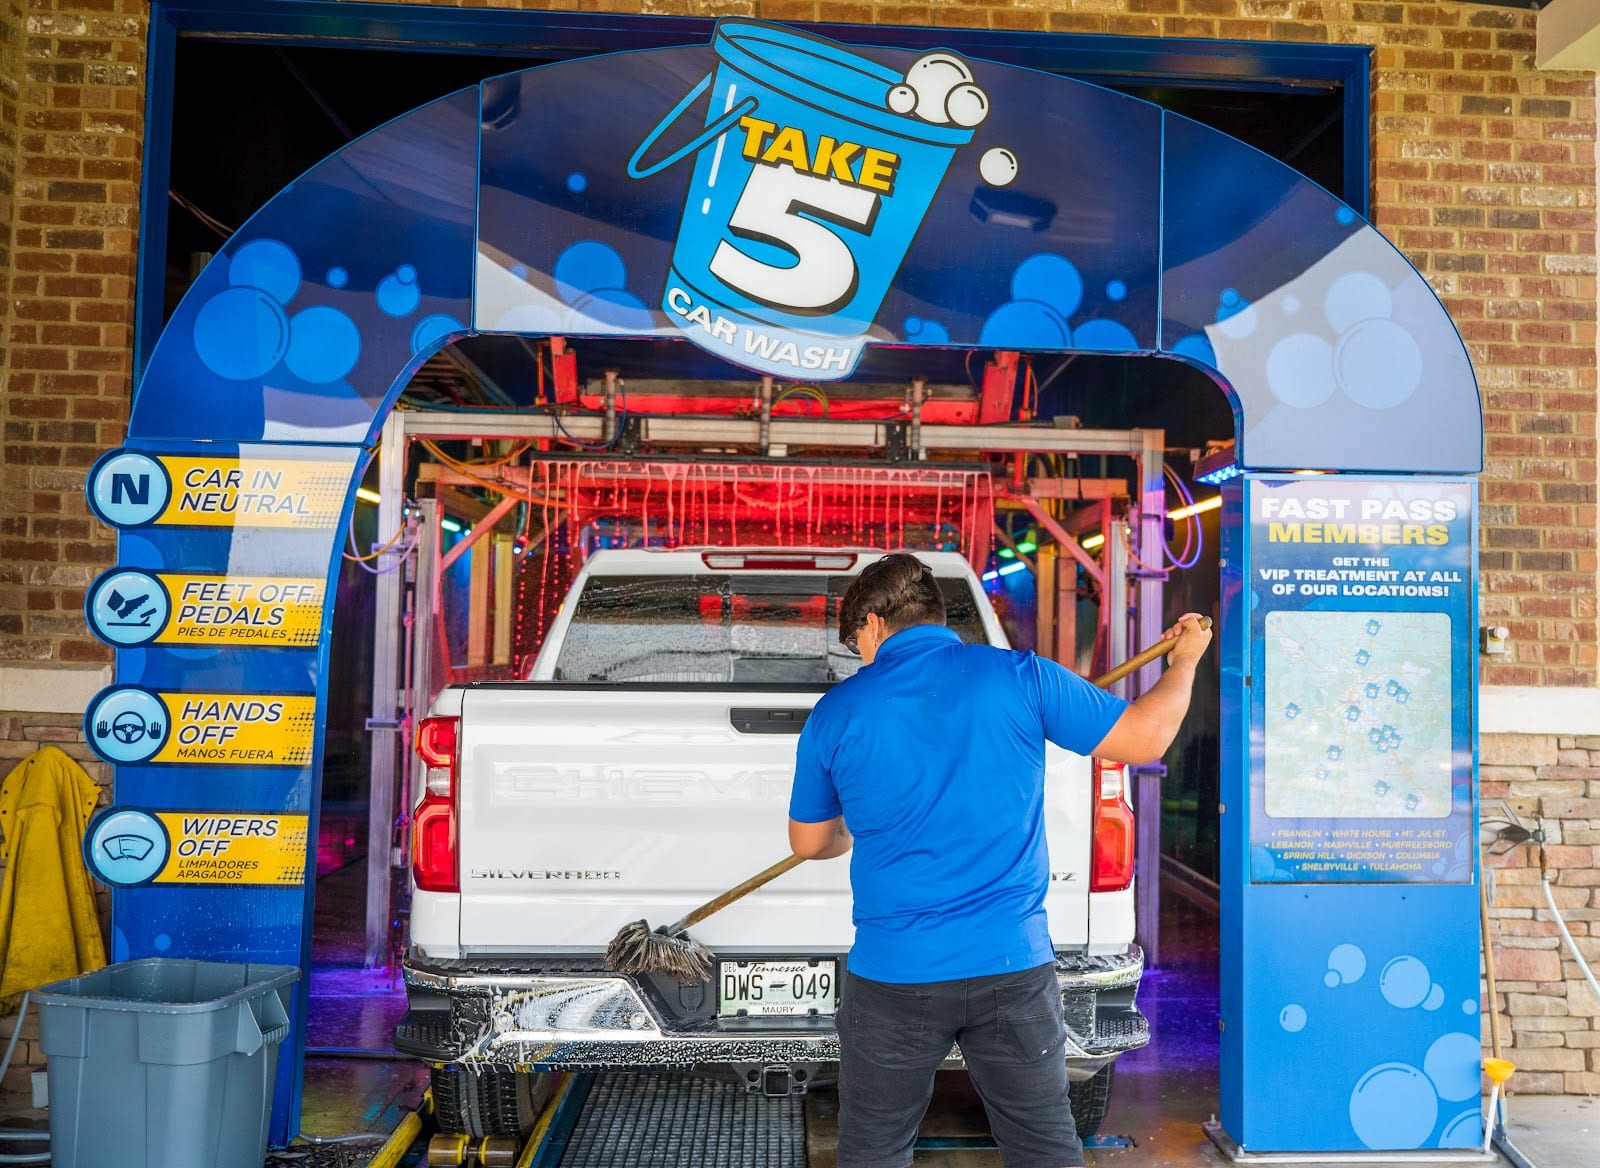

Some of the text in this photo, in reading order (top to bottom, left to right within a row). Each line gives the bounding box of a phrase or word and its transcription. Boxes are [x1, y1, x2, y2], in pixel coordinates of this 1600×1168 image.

[739, 115, 898, 194] TAKE
[708, 163, 880, 312] 5
[667, 287, 852, 371] CAR WASH
[184, 468, 282, 490] CAR IN
[111, 473, 150, 505] N
[179, 492, 311, 515] NEUTRAL
[1260, 497, 1457, 522] FAST PASS
[1268, 522, 1449, 546] MEMBERS
[1332, 556, 1389, 567] GET THE
[1259, 568, 1462, 583] VIP TREATMENT AT ALL
[182, 582, 315, 604] FEET OFF
[1272, 583, 1449, 597] OF OUR LOCATIONS!
[177, 605, 285, 625] PEDALS
[177, 627, 287, 639] PIES DE PEDALES
[180, 701, 283, 722] HANDS
[178, 725, 238, 745] OFF
[176, 748, 274, 760] MANOS FUERA
[182, 817, 279, 837] WIPERS
[1278, 830, 1322, 838] FRANKLIN
[1331, 830, 1360, 839] WHITE
[1361, 830, 1393, 839] HOUSE
[1417, 830, 1447, 838] JULIET
[177, 839, 231, 857] OFF
[1271, 841, 1453, 849] LEBANON NASHVILLE MURFREESBORO
[1283, 851, 1441, 860] SPRING HILL DICKSON COLUMBIA
[177, 860, 260, 870] LIMPIADORES
[1301, 862, 1423, 871] SHELBYVILLE TULLAHOMA
[176, 870, 243, 880] APAGADOS
[723, 962, 737, 973] DEC
[749, 962, 807, 975] Tennessee
[724, 973, 831, 1001] DWS 049
[762, 1006, 795, 1014] MAURY
